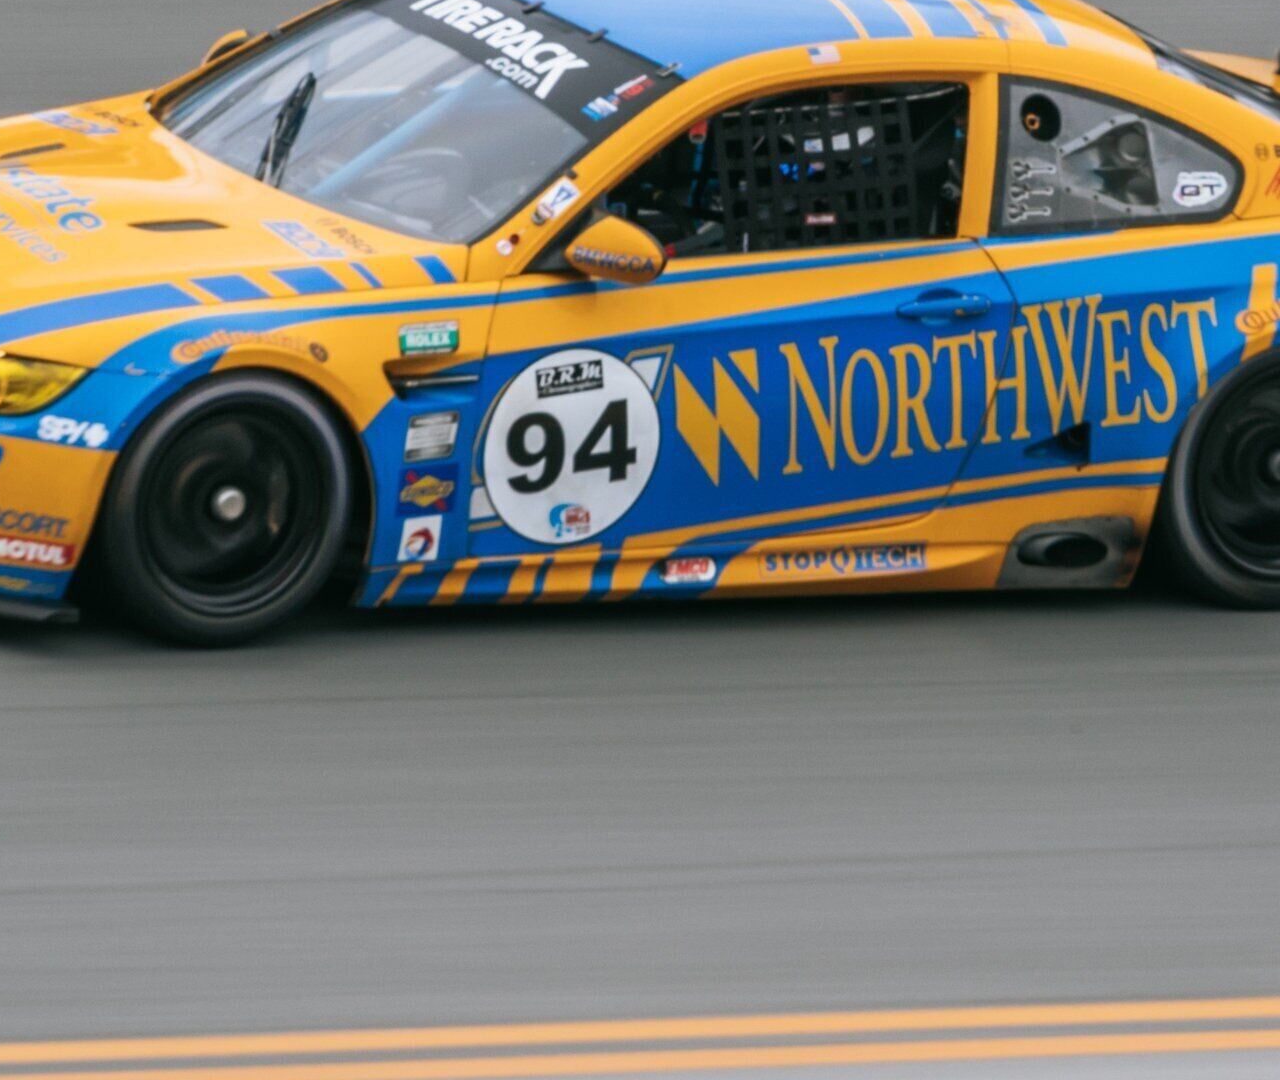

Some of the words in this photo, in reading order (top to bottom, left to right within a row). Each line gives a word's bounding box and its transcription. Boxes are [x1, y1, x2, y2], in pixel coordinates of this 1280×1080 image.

[405, 329, 451, 349] ROLEX
[778, 293, 1219, 475] NORTHWEST
[506, 398, 637, 495] 94
